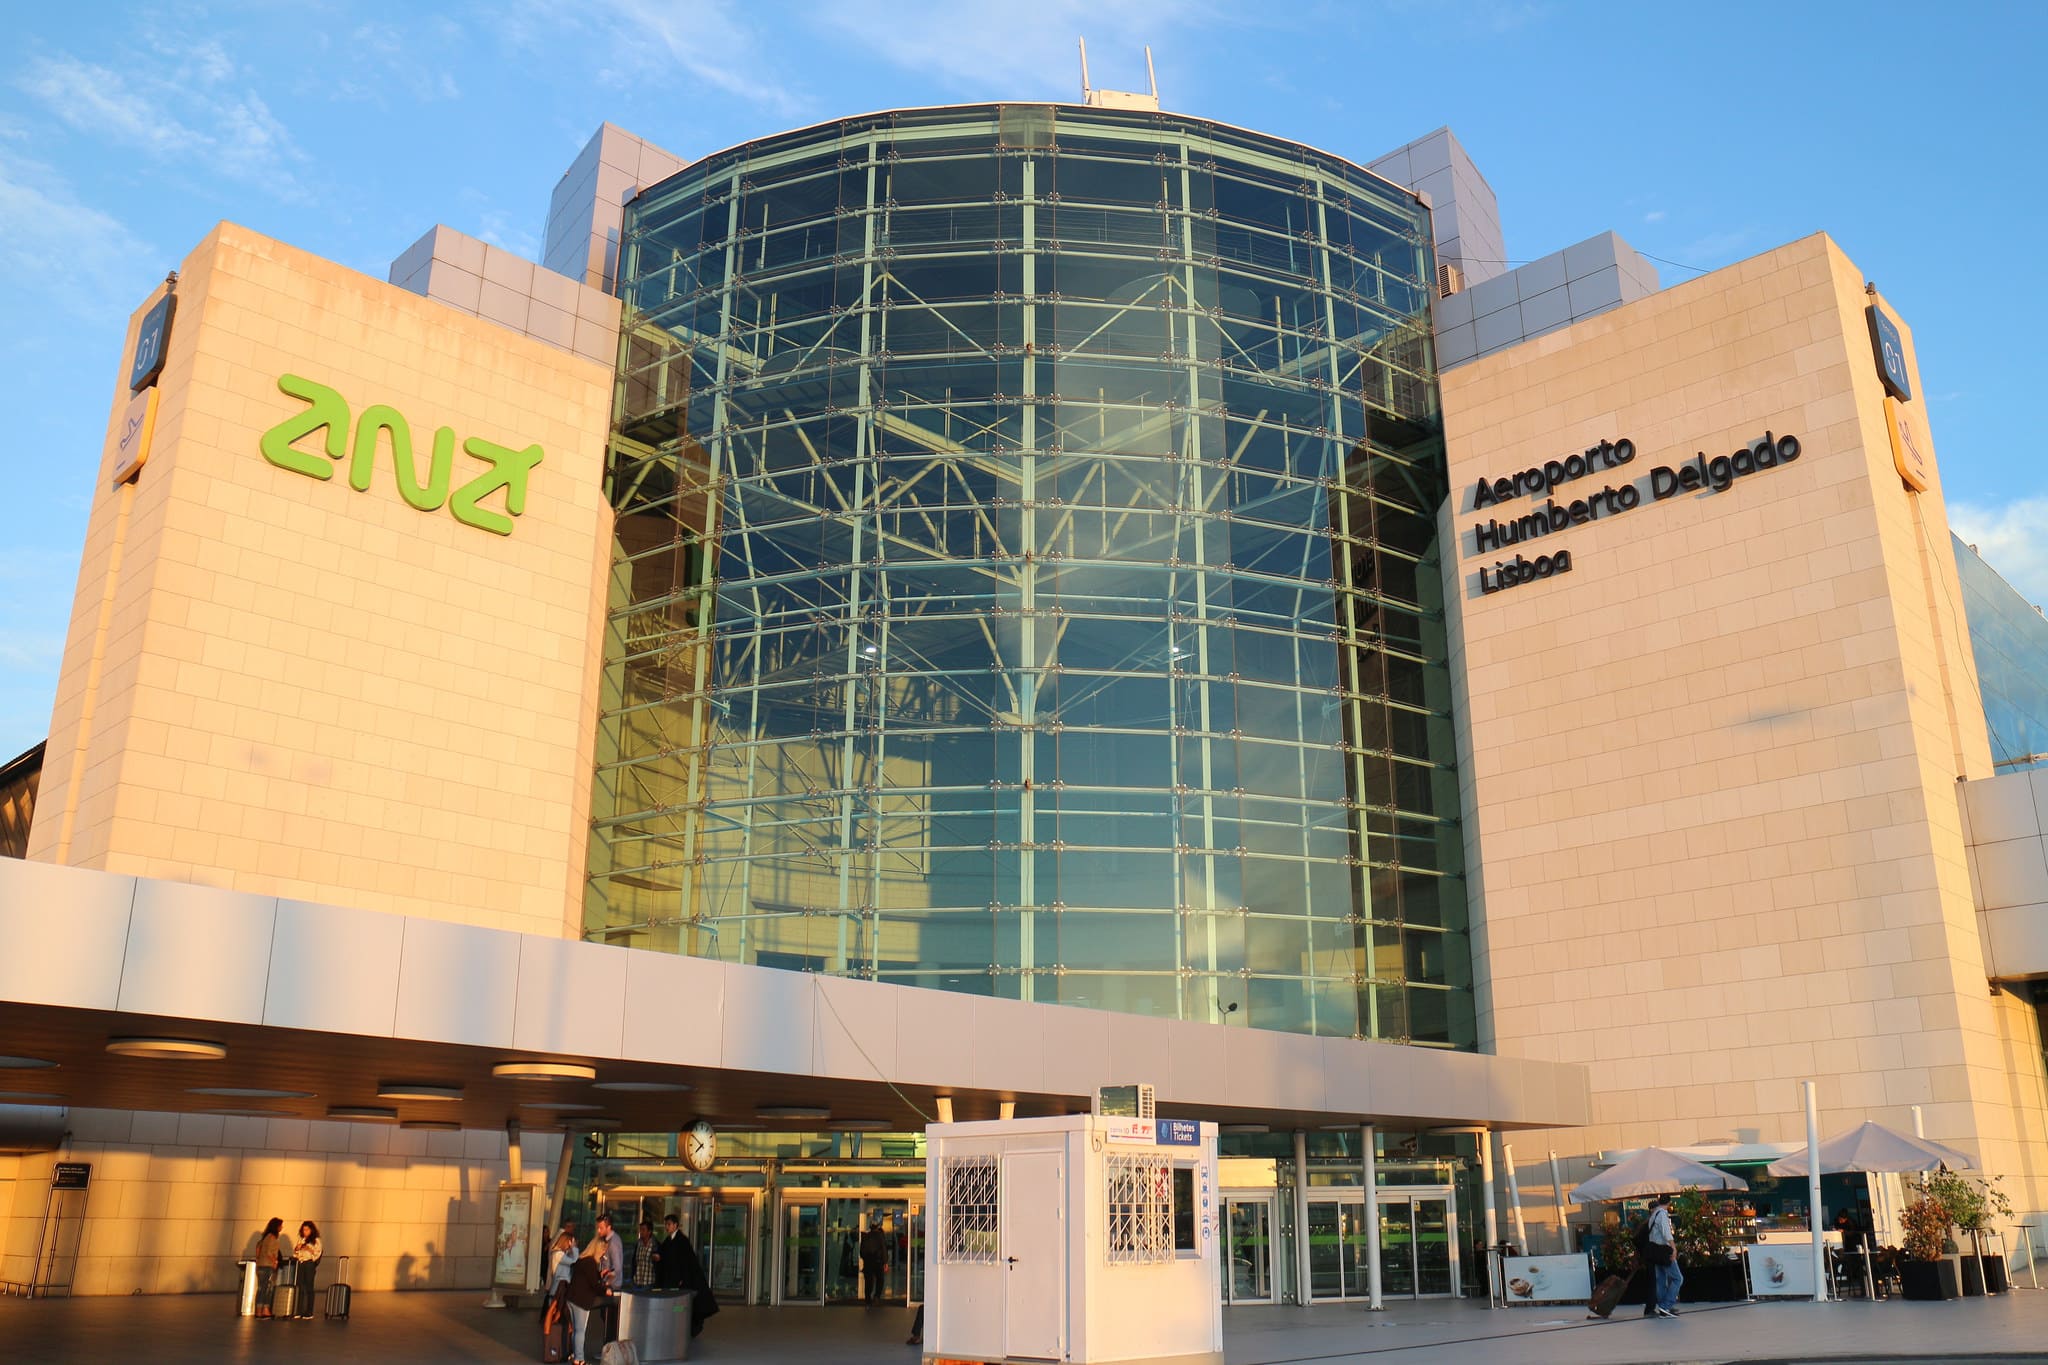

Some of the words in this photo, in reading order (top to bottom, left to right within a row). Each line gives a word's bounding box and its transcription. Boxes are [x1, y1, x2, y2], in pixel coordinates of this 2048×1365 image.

[1473, 438, 1636, 510] Aeroporto
[1475, 483, 1640, 553] Humberto
[1650, 430, 1802, 500] Delgado
[1480, 549, 1573, 594] Lisboa
[1173, 1122, 1195, 1133] Bilhetes
[1173, 1131, 1192, 1142] Tickets
